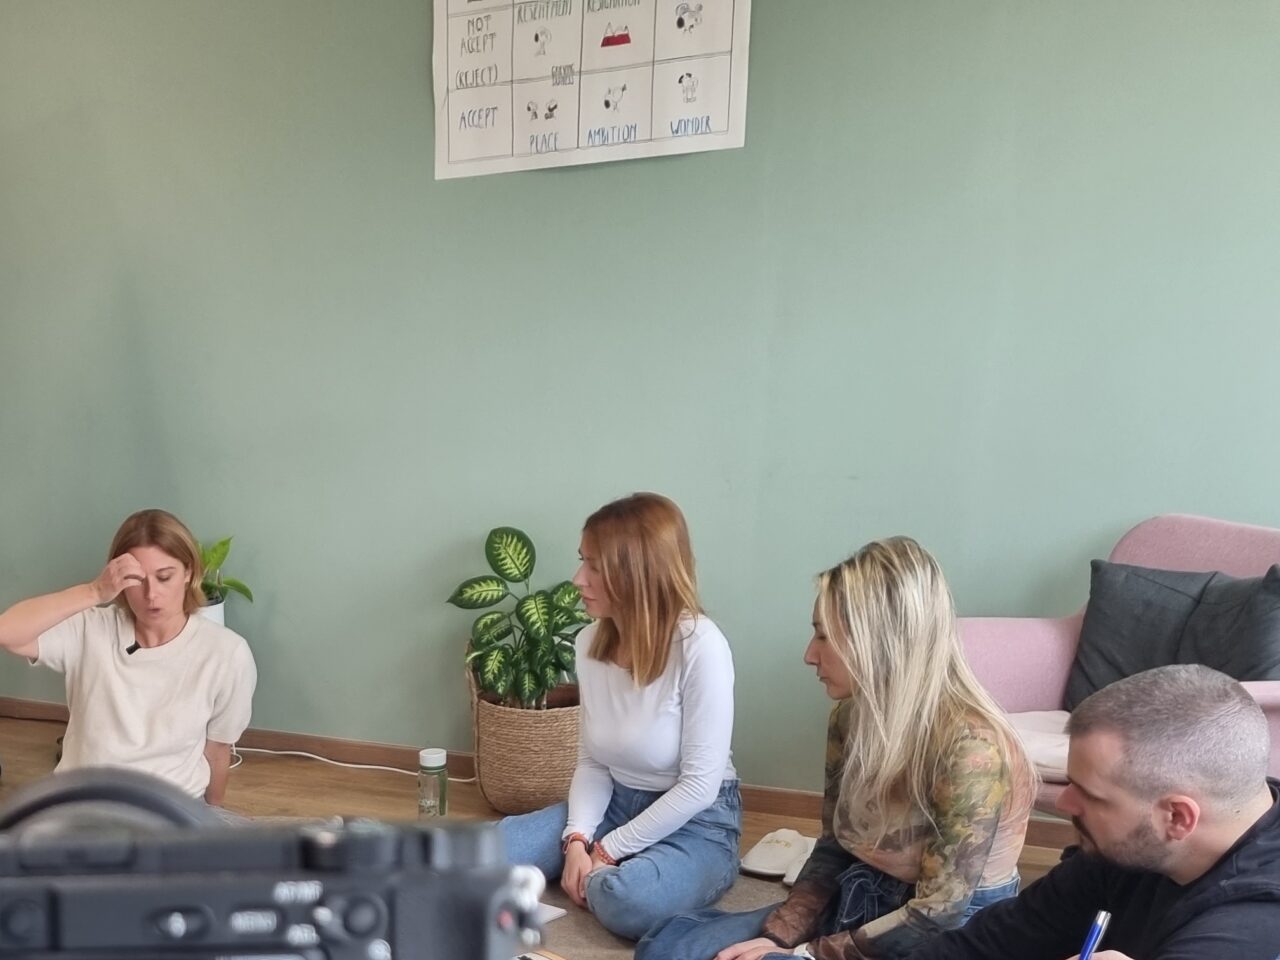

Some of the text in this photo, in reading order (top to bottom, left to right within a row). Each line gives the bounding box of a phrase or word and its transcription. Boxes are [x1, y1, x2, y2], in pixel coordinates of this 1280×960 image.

[467, 14, 492, 35] NOT
[460, 32, 496, 57] ACCEPT
[455, 64, 498, 89] (REJECT)
[459, 106, 498, 131] ACCEPT
[670, 115, 712, 136] WONDER
[529, 132, 559, 154] PEACE
[587, 123, 638, 146] AMBITION
